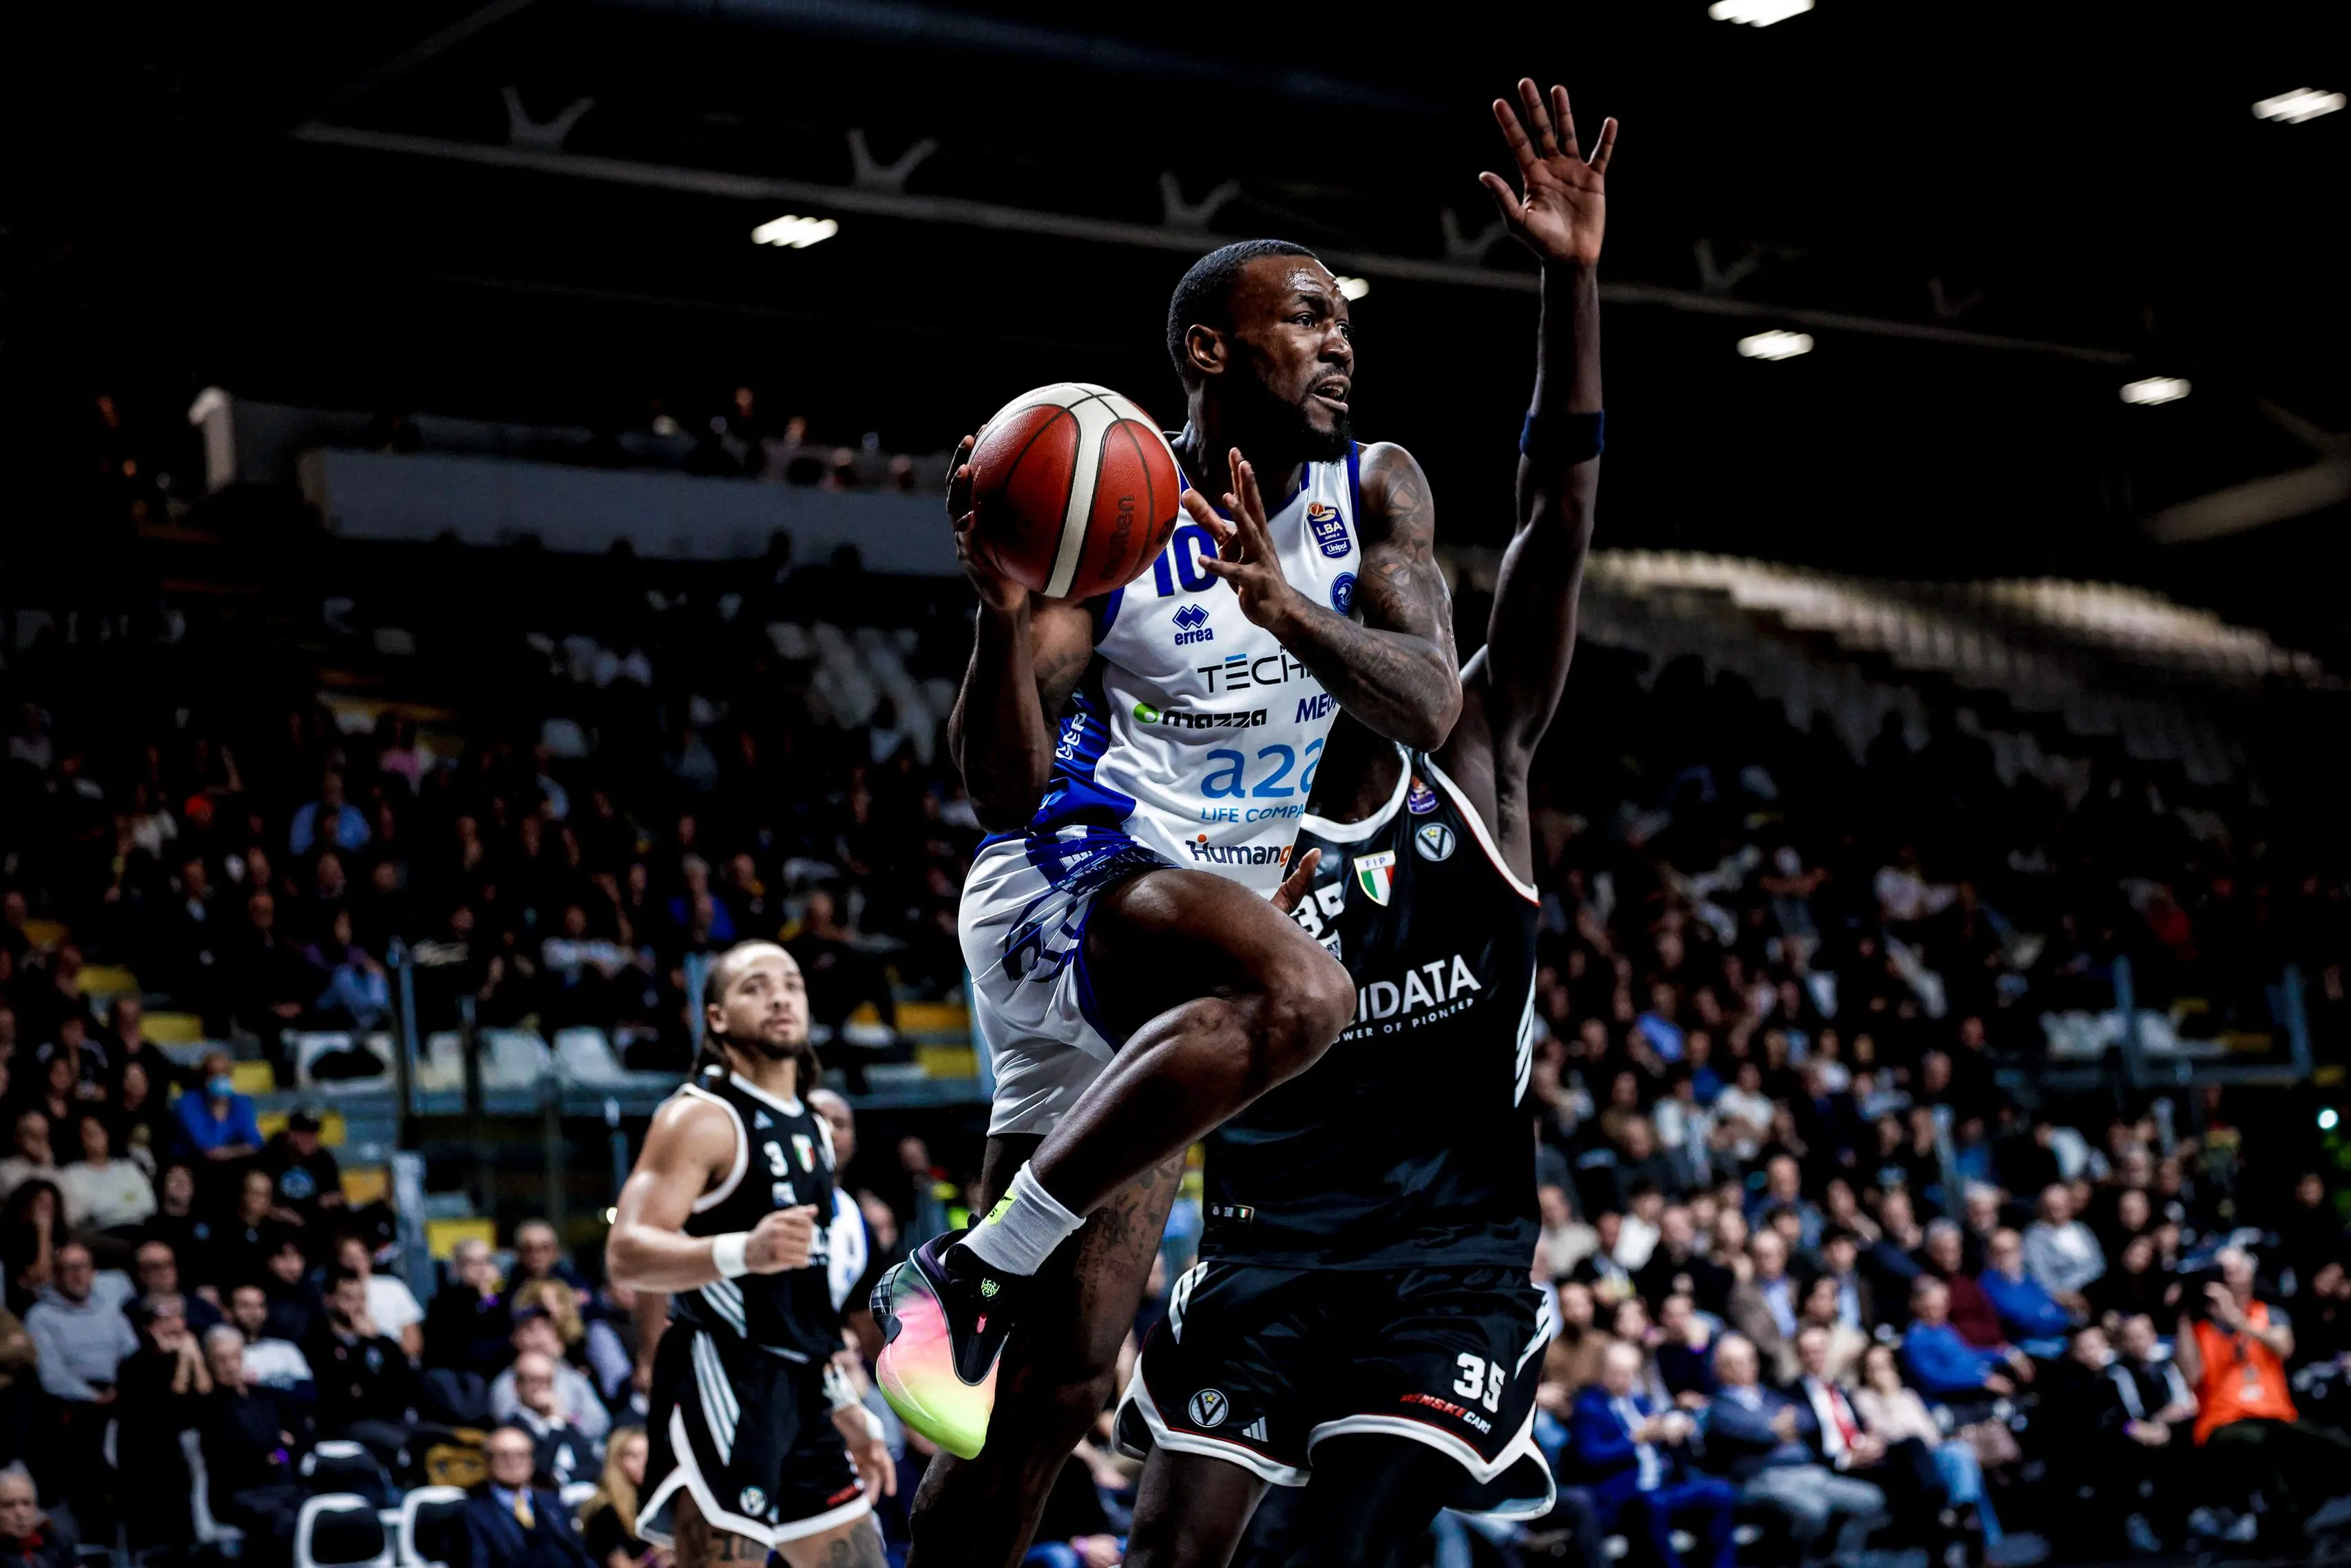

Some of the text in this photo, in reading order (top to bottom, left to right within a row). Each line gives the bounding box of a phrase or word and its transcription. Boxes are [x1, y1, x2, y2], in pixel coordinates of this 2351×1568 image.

[1315, 521, 1344, 536] LBA
[1326, 541, 1348, 553] Unipol
[1153, 524, 1220, 598] 10
[1174, 627, 1214, 646] errea
[1197, 653, 1311, 693] TECH
[1162, 708, 1268, 729] mazza
[1200, 807, 1239, 823] LIFE
[1185, 839, 1293, 868] Humang
[1365, 856, 1386, 868] FIP
[1347, 954, 1483, 1027] IDATA
[1383, 1022, 1403, 1034] OF
[762, 1140, 789, 1178] 3
[1452, 1352, 1507, 1414] 35
